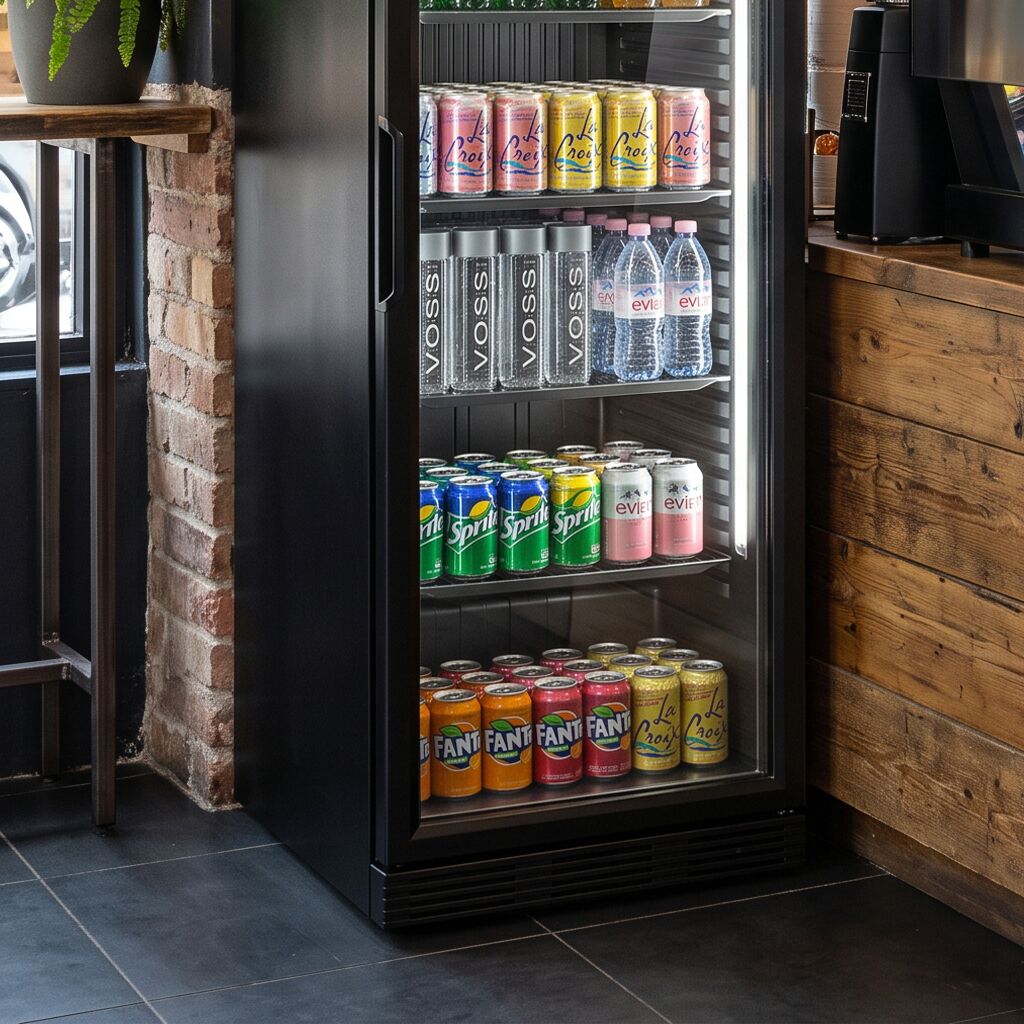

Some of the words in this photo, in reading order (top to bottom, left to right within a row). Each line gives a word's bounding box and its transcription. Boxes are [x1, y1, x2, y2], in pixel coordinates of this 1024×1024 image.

[425, 272, 440, 374] VOSS
[474, 271, 488, 371] VOSS
[522, 268, 537, 368] VOSS
[568, 266, 584, 365] VOSS
[433, 730, 480, 758] FANT
